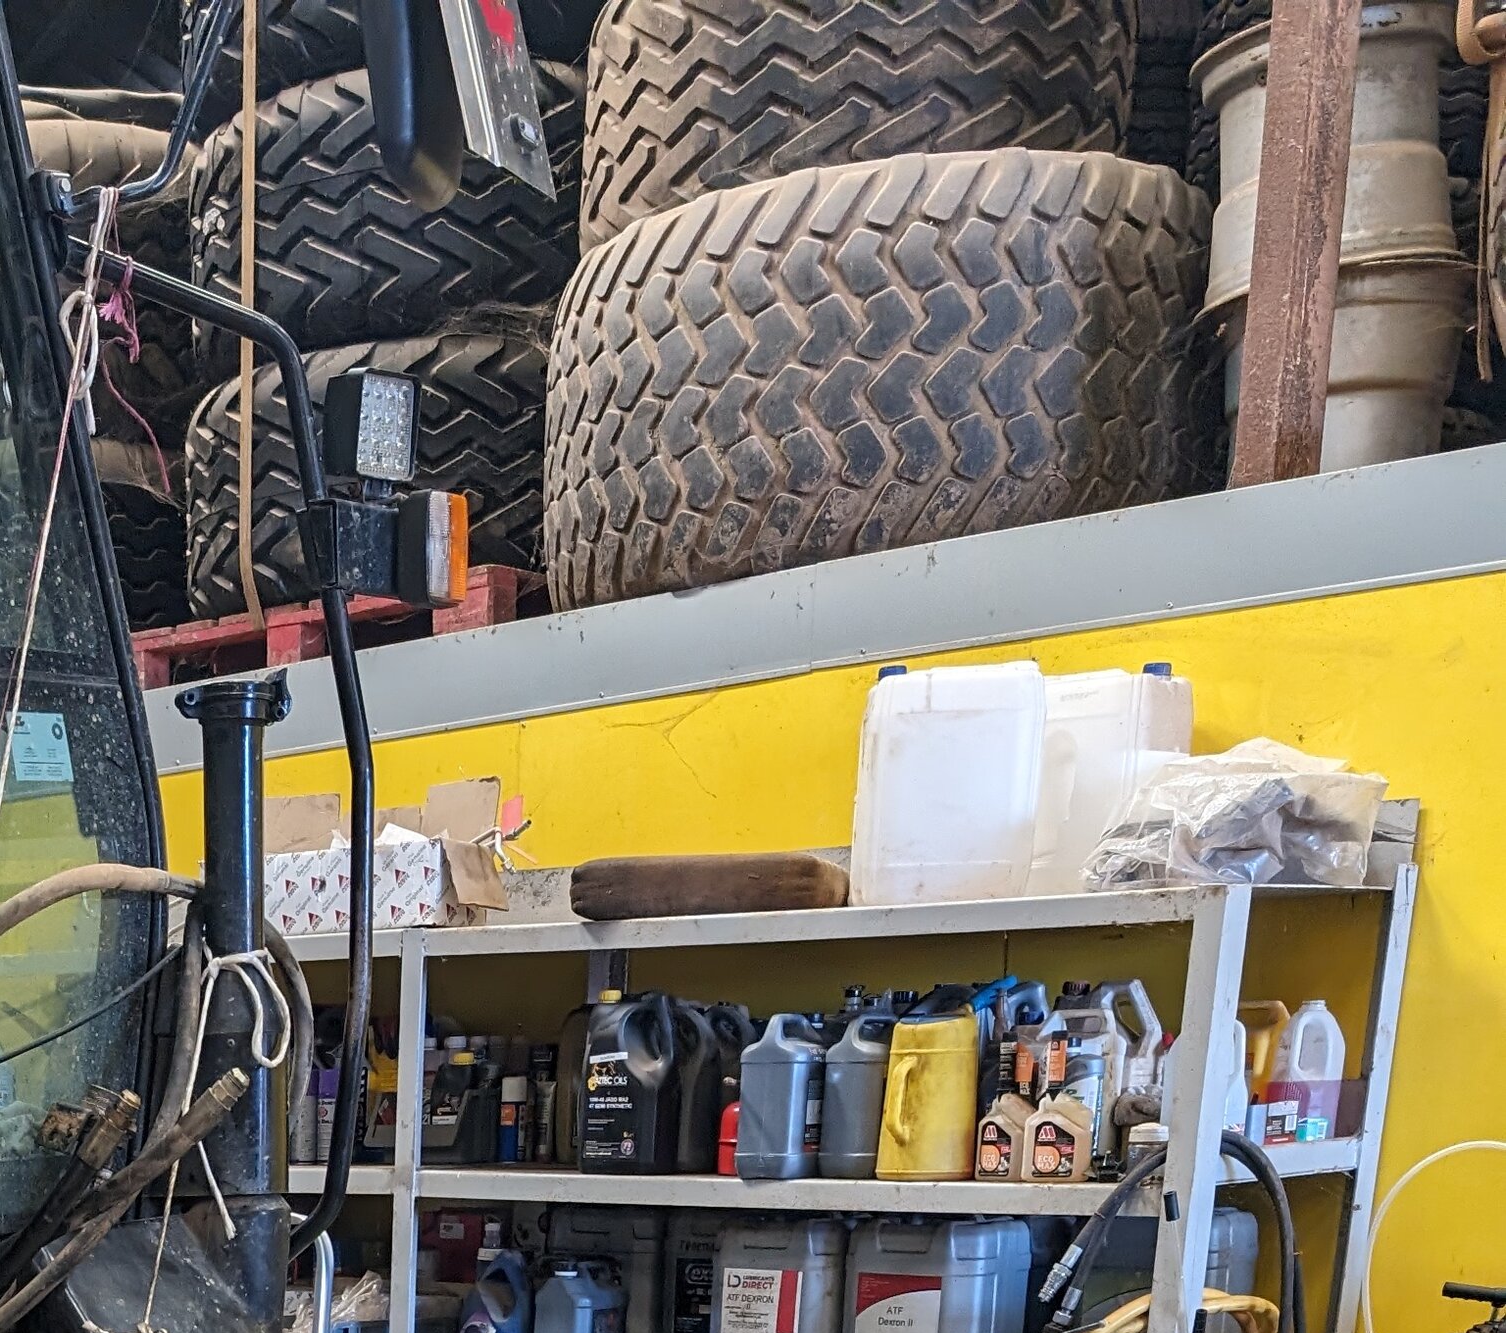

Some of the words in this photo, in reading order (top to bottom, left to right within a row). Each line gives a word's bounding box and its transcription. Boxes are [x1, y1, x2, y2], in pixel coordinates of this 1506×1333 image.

[614, 1076, 628, 1085] OILS
[1038, 1155, 1054, 1164] ECO
[1037, 1162, 1056, 1171] MAX
[742, 1281, 775, 1290] DIRECT
[726, 1293, 740, 1302] ATF
[741, 1294, 775, 1303] DEXRON
[886, 1306, 904, 1315] ATF
[878, 1317, 905, 1327] Dexron
